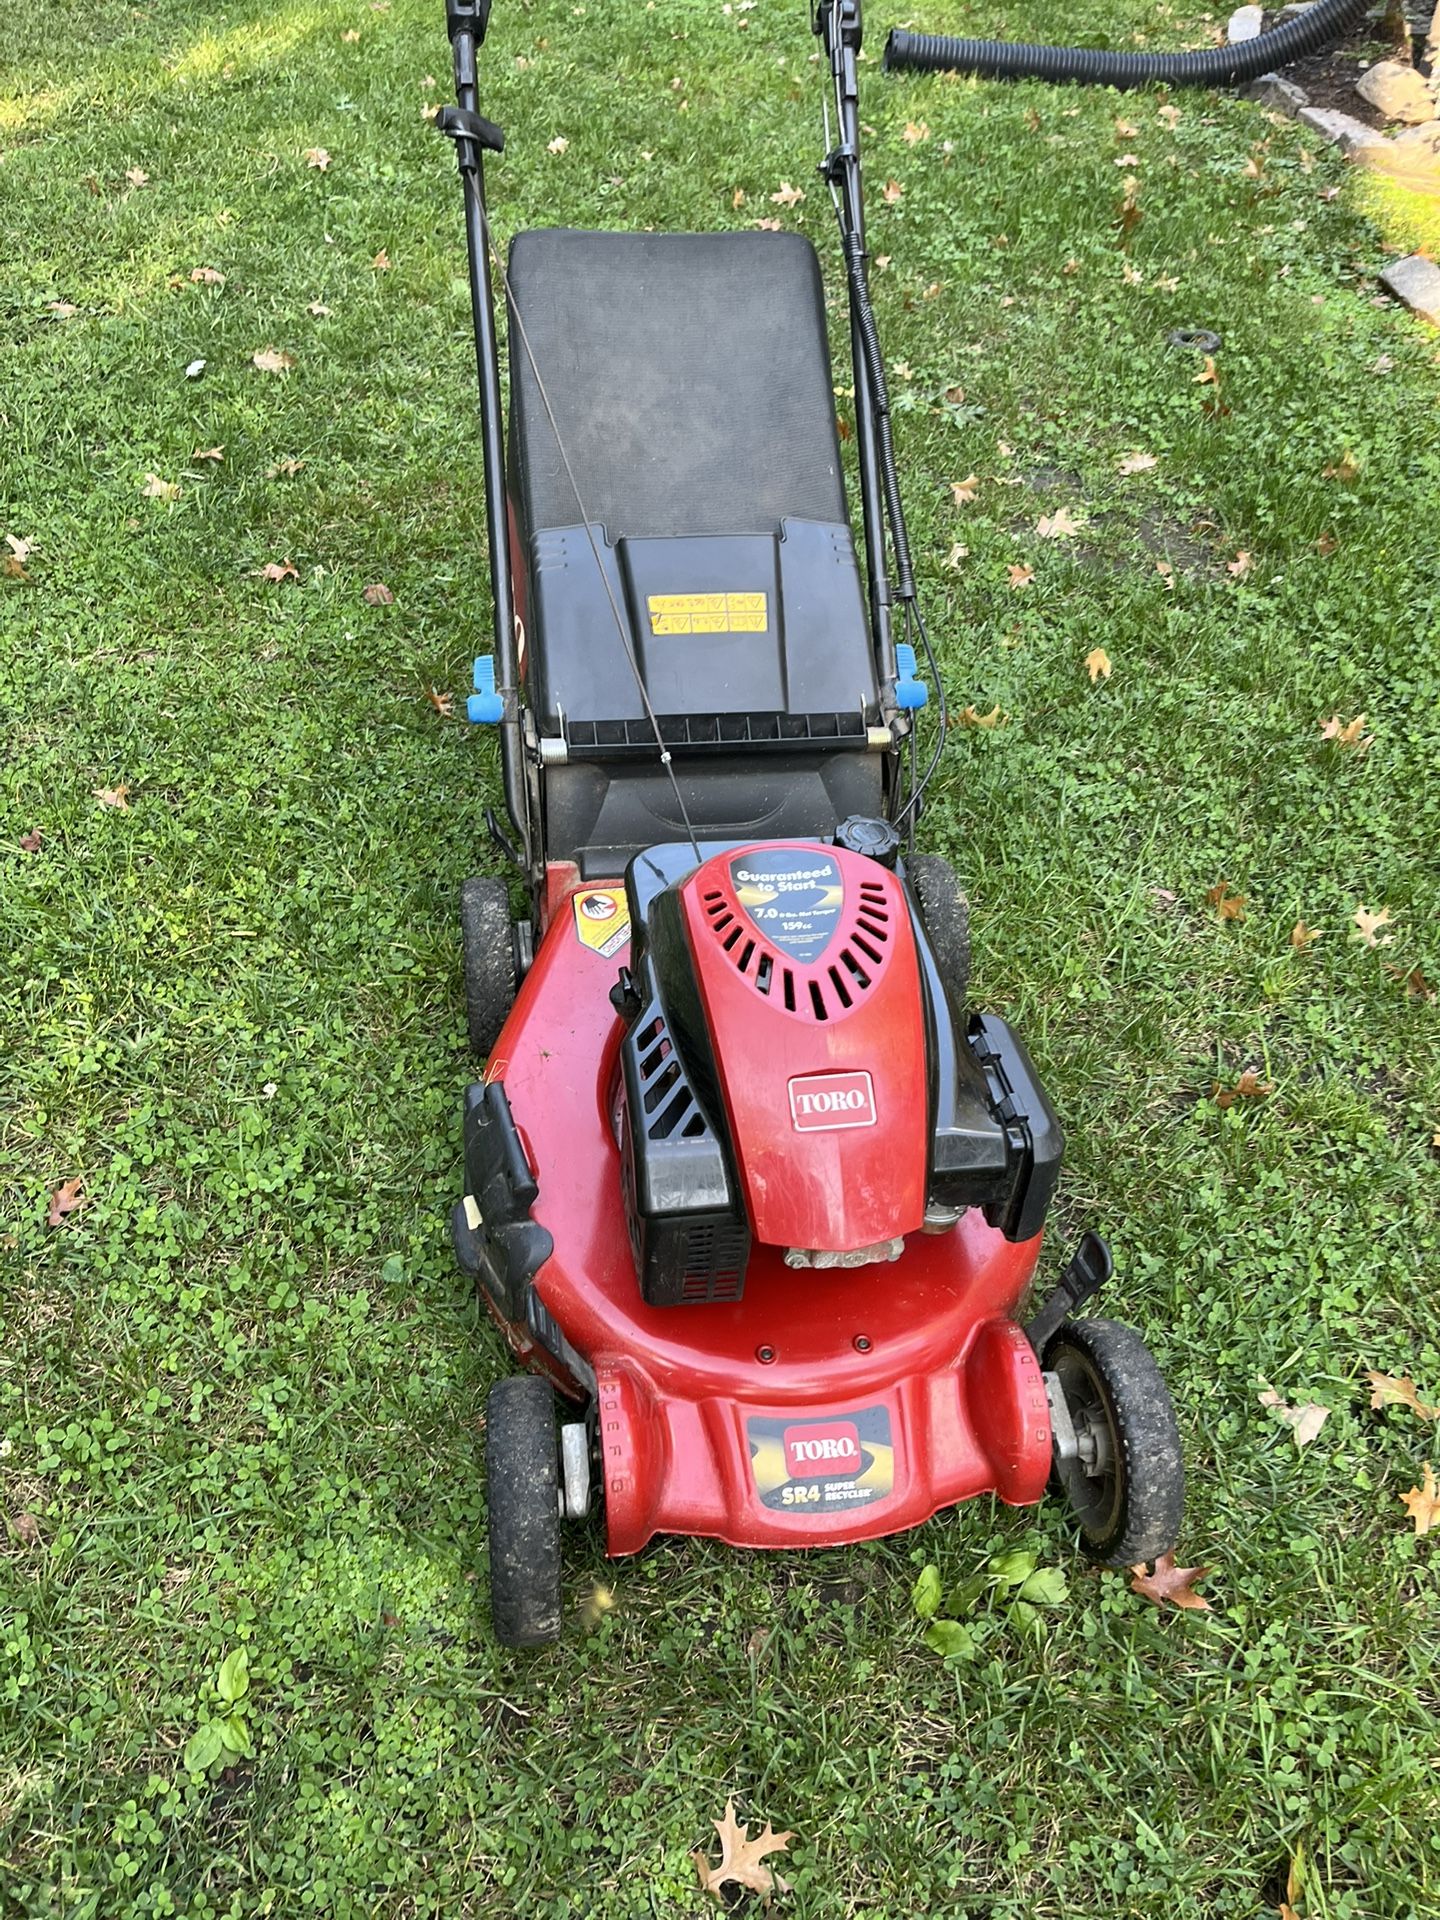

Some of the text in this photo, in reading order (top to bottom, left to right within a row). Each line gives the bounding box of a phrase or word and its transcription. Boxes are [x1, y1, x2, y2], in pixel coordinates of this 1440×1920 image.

[737, 865, 832, 882] Guaranteed
[757, 880, 817, 892] to Start
[754, 907, 778, 918] 7.0
[782, 921, 813, 931] 159cc
[796, 1089, 865, 1114] TORO
[790, 1437, 857, 1462] TORO
[782, 1481, 856, 1505] SR4 SUPER
[825, 1488, 873, 1501] RECYCLER
